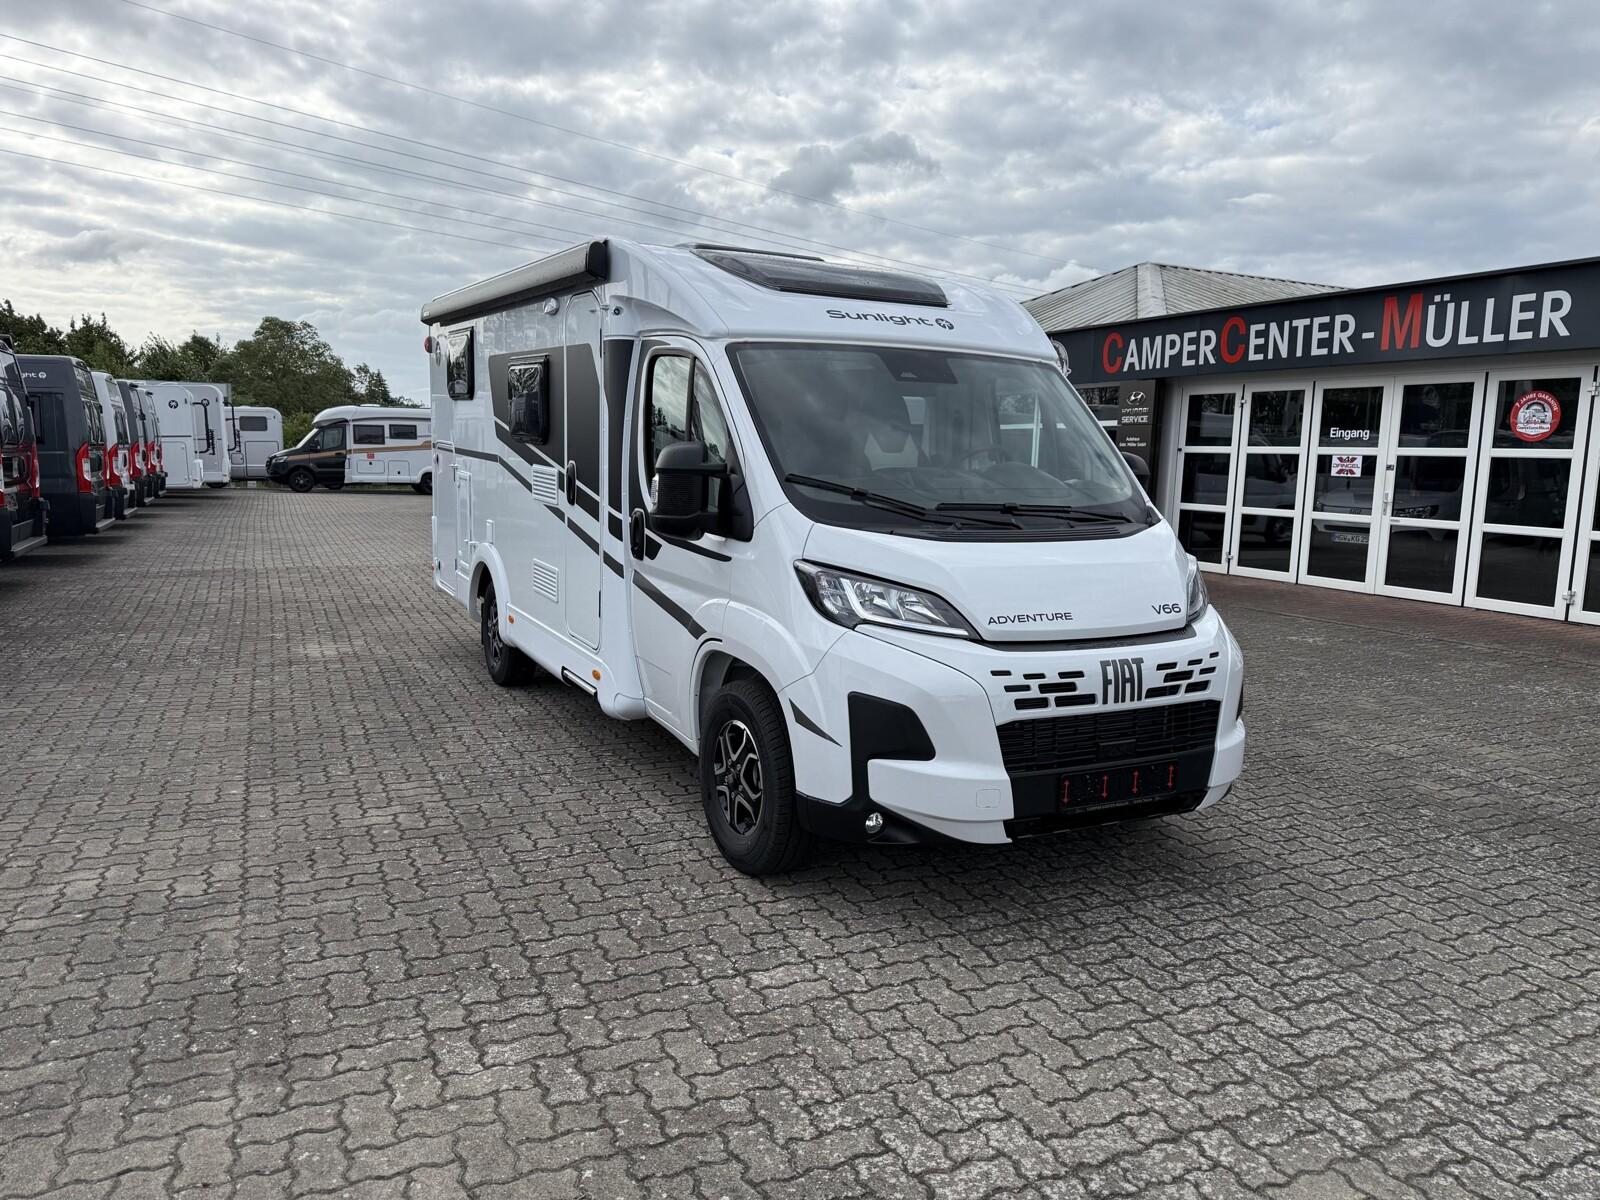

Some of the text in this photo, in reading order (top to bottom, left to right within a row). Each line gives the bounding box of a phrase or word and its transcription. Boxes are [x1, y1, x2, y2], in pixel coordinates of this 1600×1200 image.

[826, 309, 933, 326] Sunlight
[1121, 415, 1148, 424] SERVICE
[1330, 427, 1370, 440] Eingang
[1152, 603, 1181, 615] V66
[988, 612, 1073, 626] ADVENTURE
[1100, 657, 1144, 705] FIAT
